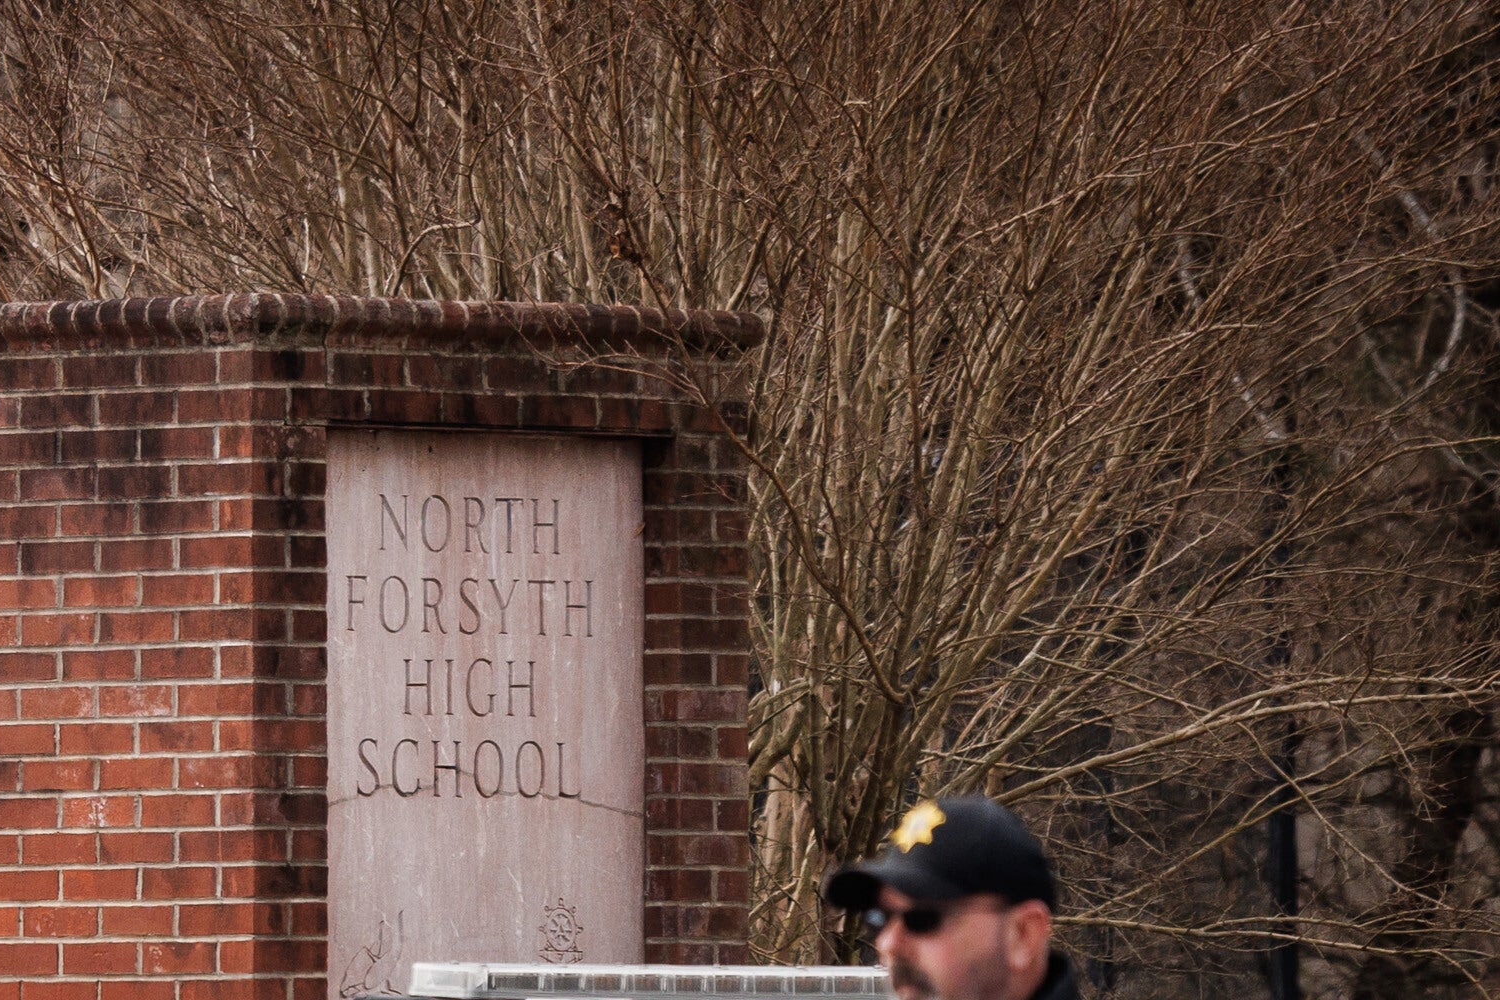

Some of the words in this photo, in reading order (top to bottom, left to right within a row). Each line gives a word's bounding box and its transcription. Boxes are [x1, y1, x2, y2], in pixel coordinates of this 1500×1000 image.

[379, 493, 561, 555] NORTH
[345, 575, 594, 637] FORSYTH
[403, 657, 537, 718] HIGH
[356, 738, 582, 799] SCHOOL
